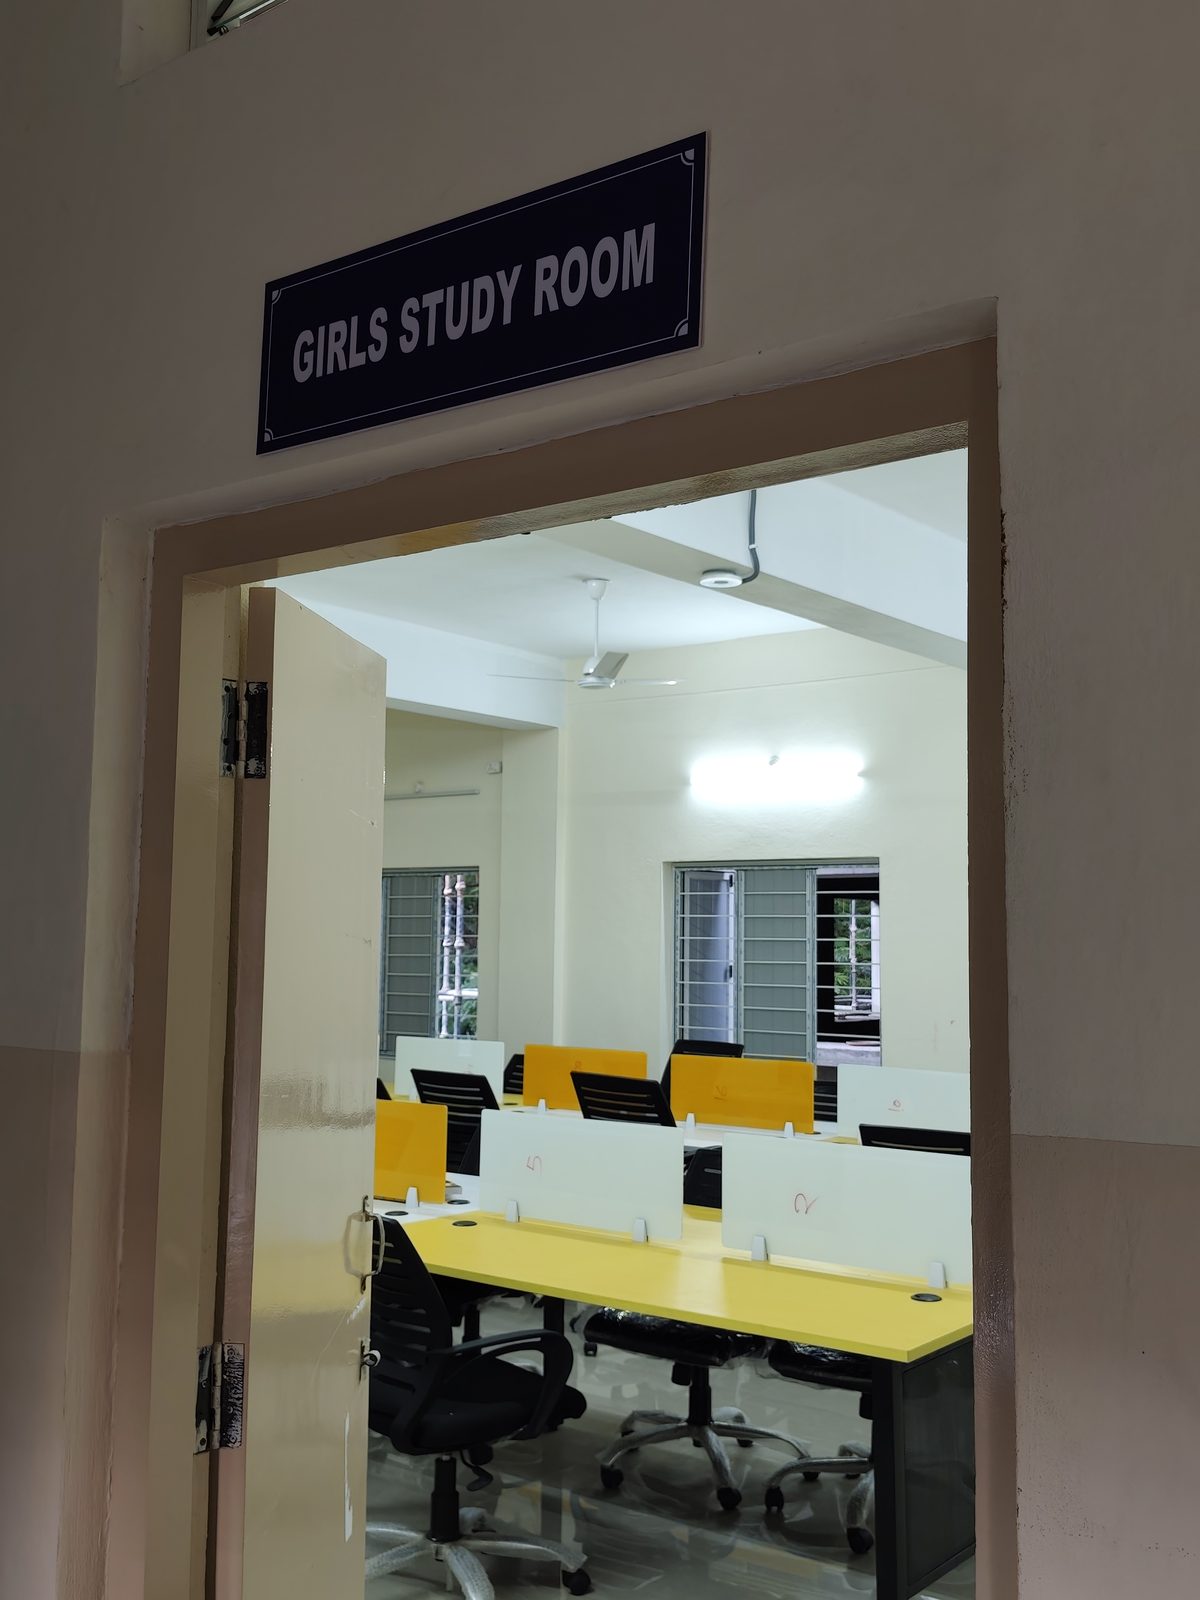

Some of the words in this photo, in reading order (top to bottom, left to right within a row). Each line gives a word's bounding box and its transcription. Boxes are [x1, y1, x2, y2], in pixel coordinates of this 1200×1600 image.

[293, 307, 388, 383] GIRLS
[399, 264, 523, 354] STUDY
[533, 223, 656, 317] ROOM
